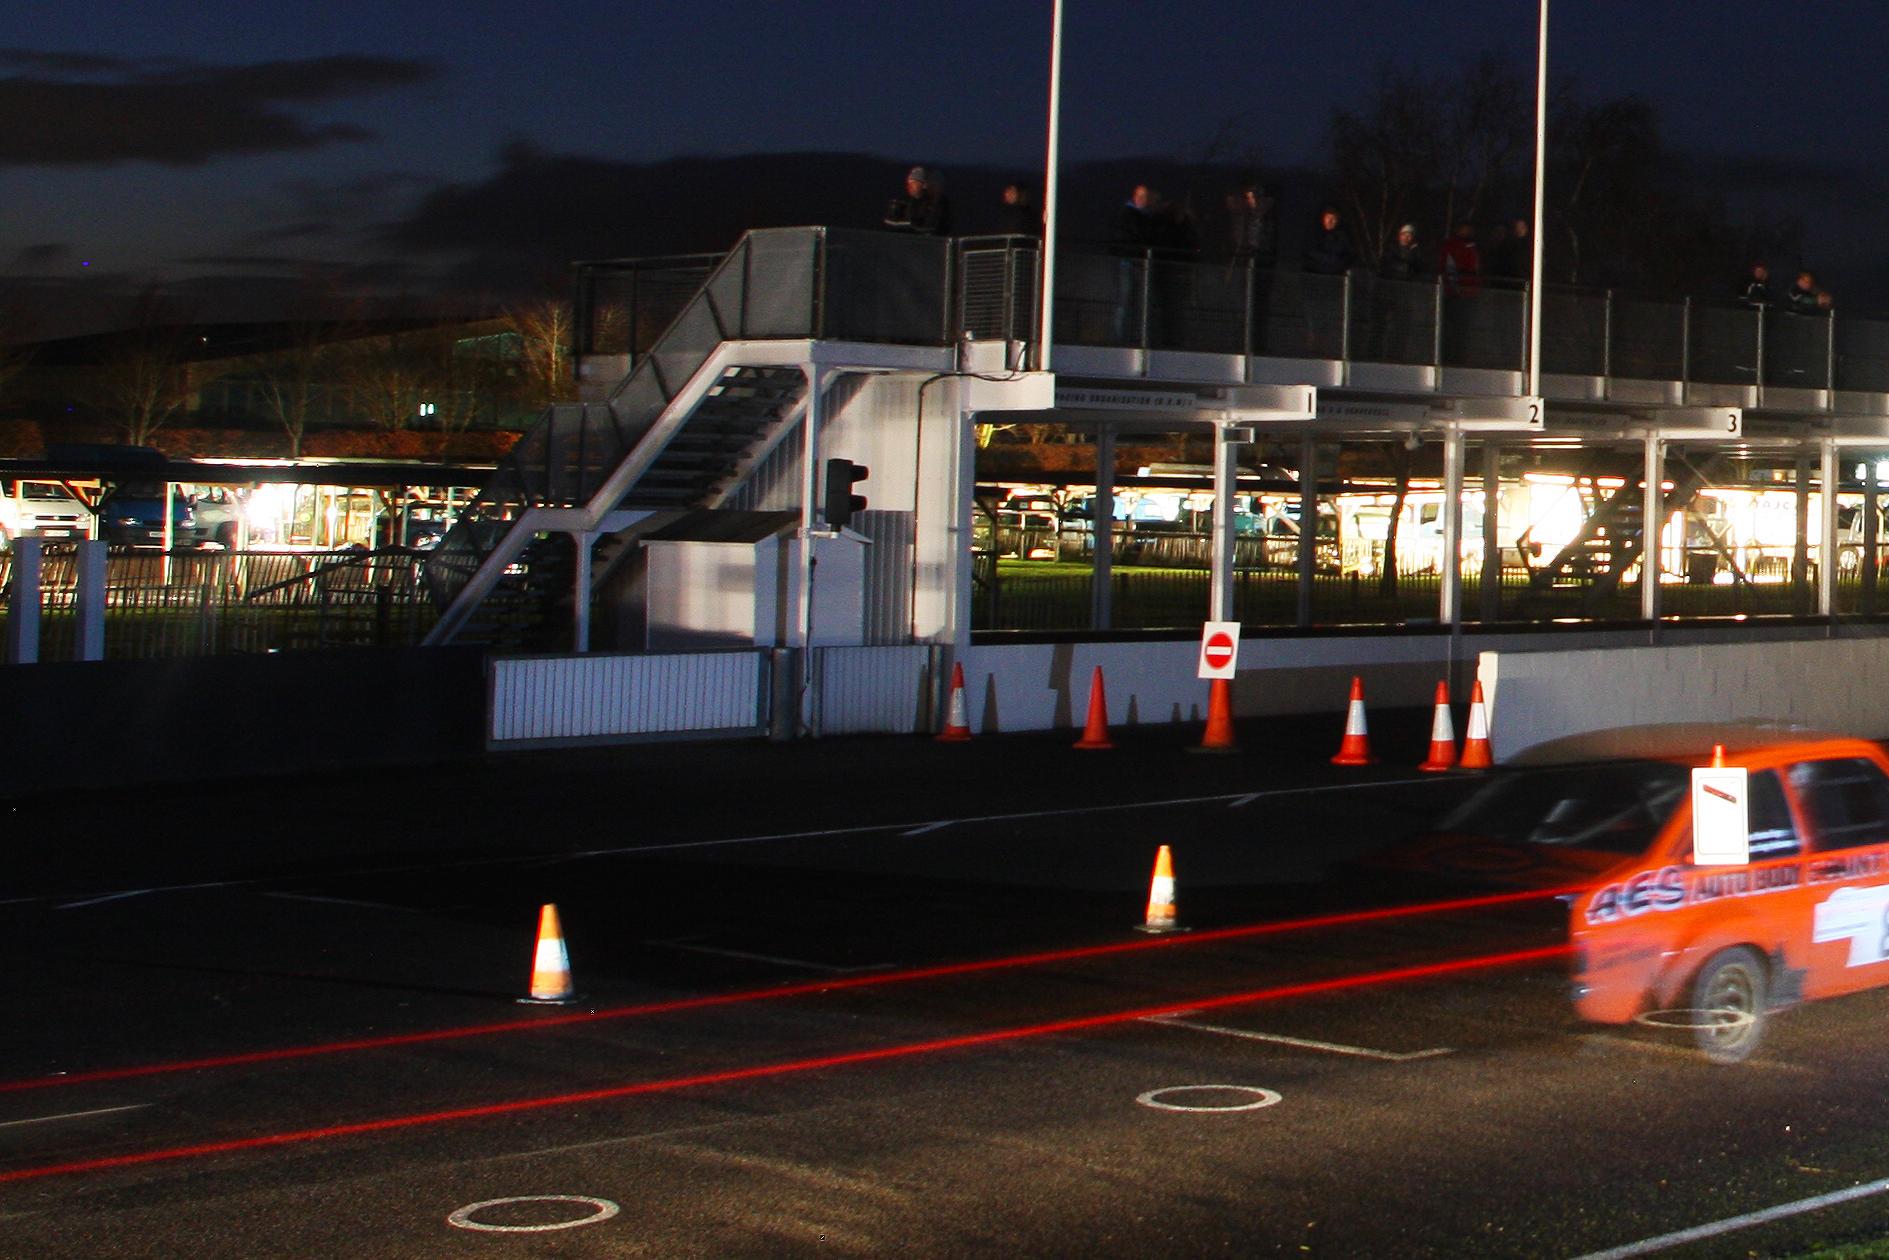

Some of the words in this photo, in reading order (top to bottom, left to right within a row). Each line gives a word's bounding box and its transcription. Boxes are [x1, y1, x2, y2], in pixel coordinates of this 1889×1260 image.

[1529, 404, 1539, 424] 2
[1728, 414, 1737, 432] 3
[1585, 865, 1684, 926] AES
